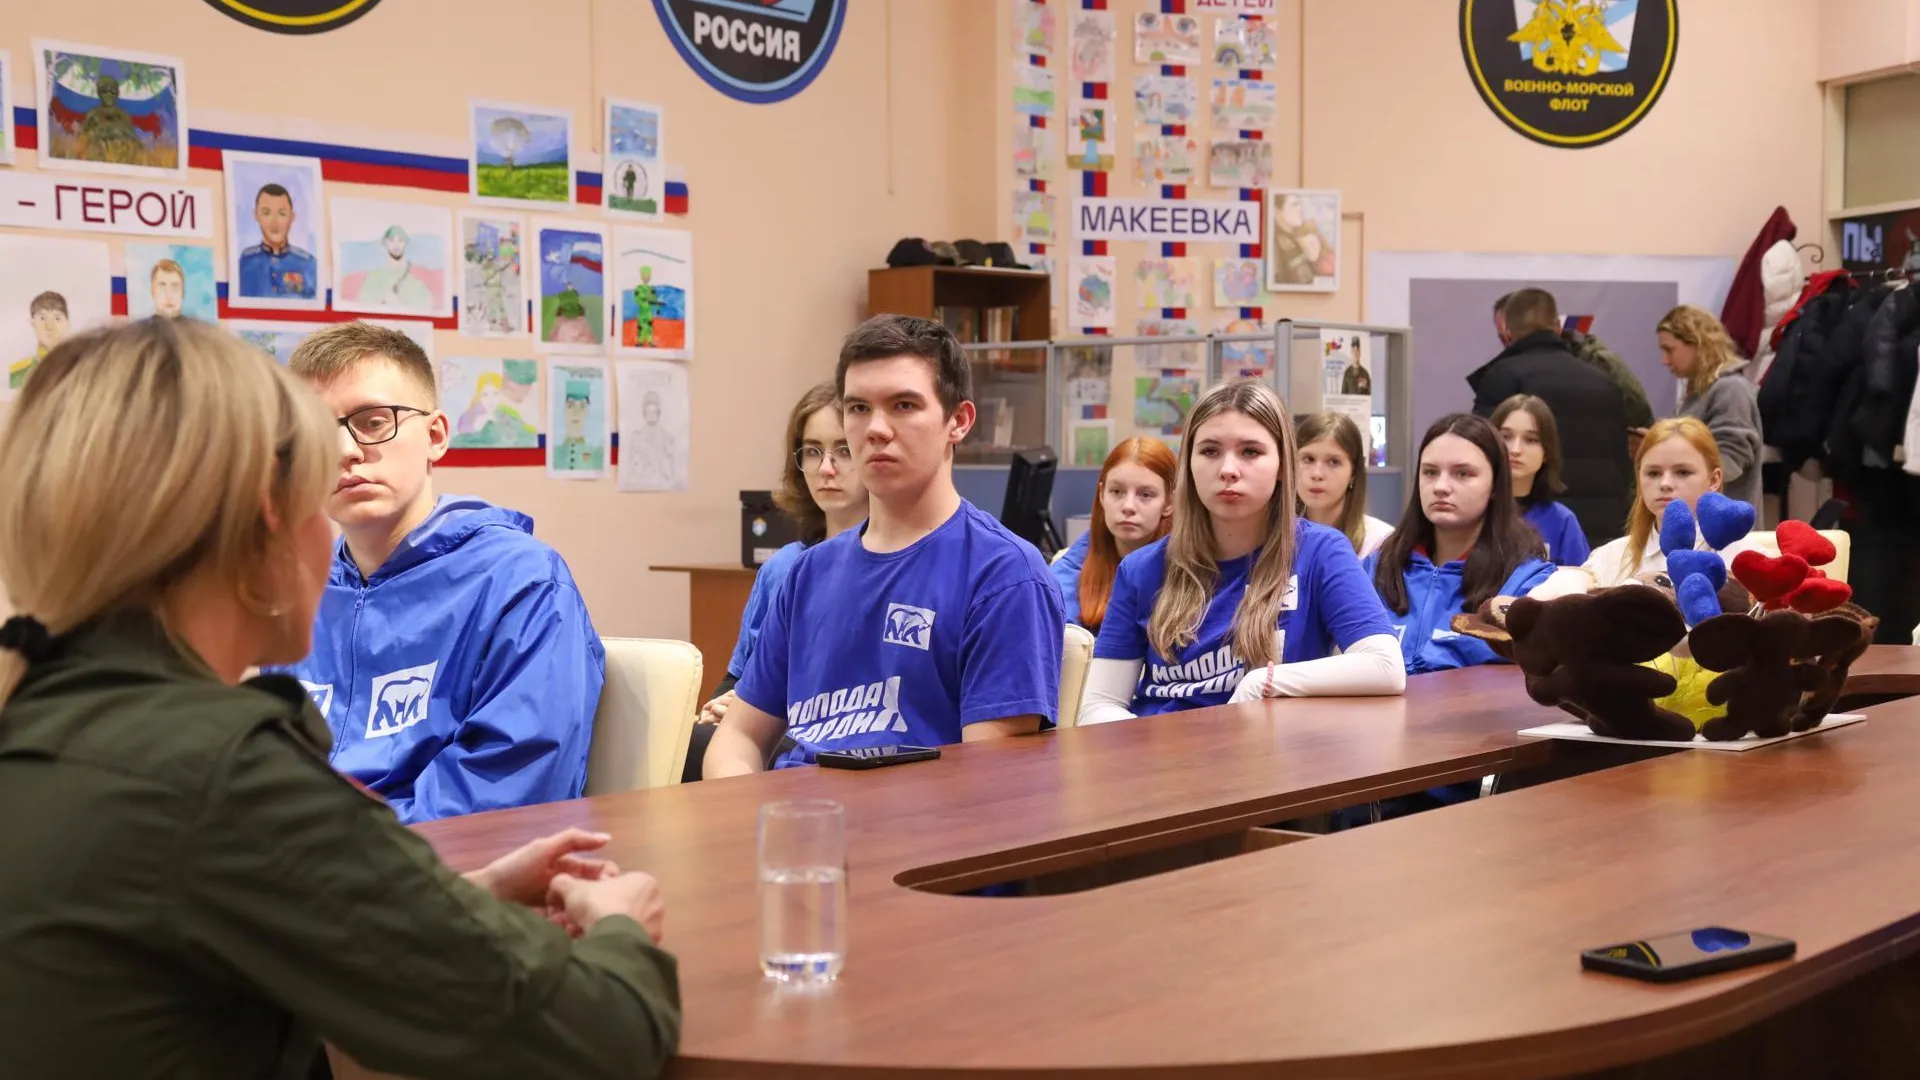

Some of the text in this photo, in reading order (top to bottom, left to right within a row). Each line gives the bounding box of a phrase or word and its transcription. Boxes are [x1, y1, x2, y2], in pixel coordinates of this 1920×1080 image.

[693, 10, 801, 63] РОССИЯ
[1503, 79, 1635, 97] ВОЕННО-МОРСКОЙ
[1549, 97, 1590, 112] ФЛОТ
[55, 184, 196, 230] ГЕРОЙ
[1080, 205, 1252, 235] МАКЕЕВКА
